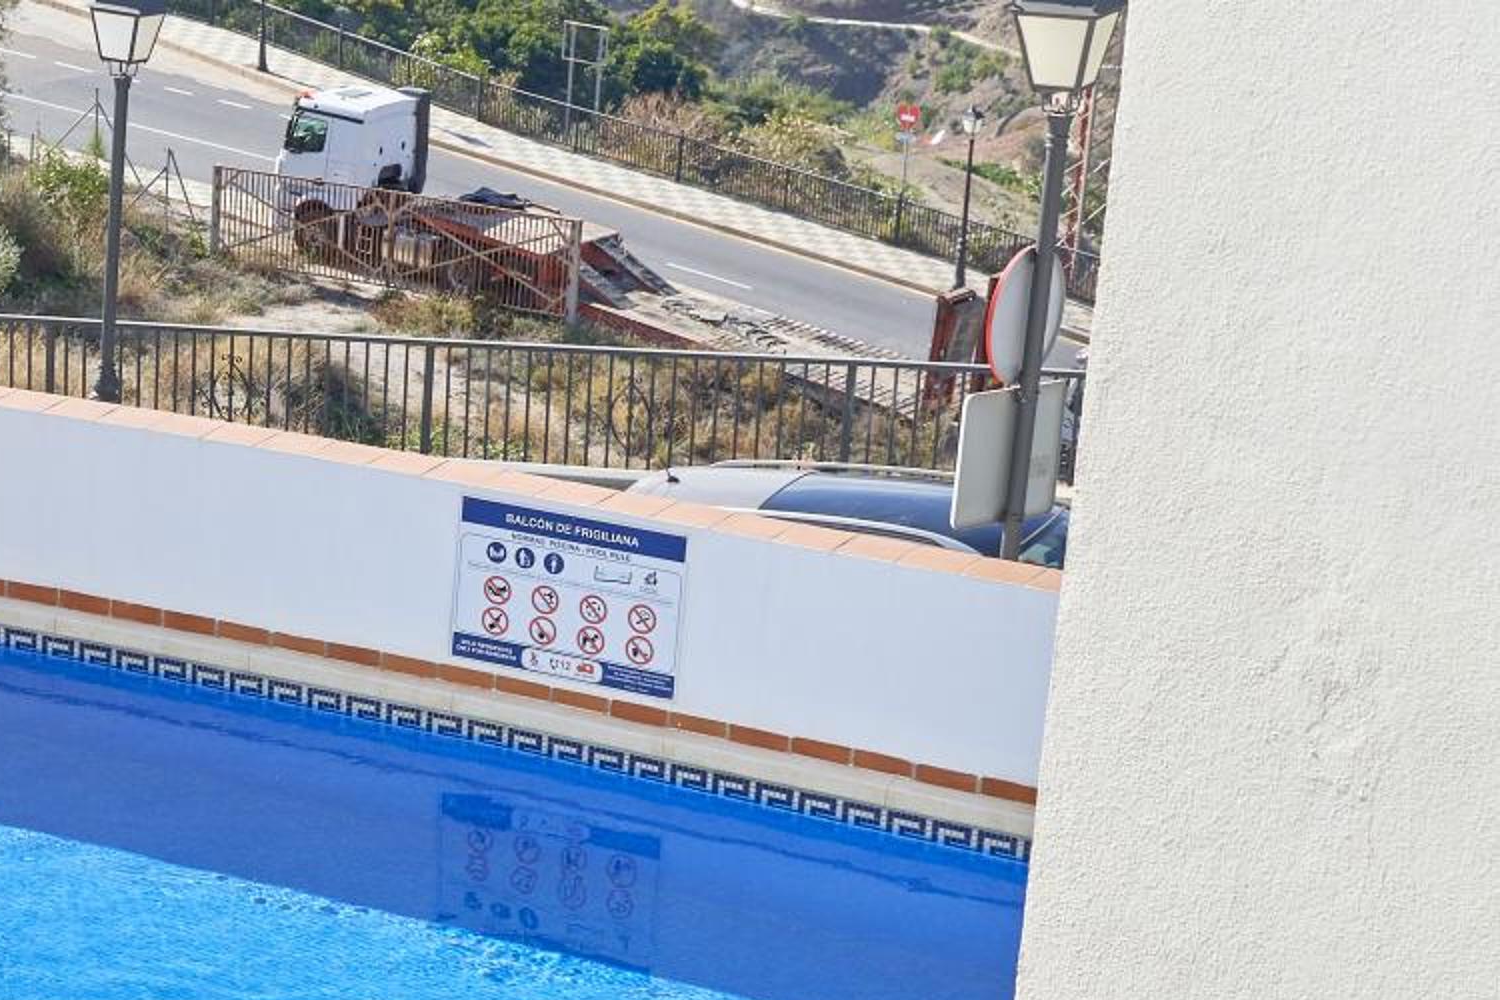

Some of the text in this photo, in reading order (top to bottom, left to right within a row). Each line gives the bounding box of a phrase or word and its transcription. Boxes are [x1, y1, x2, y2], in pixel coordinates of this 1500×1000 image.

[505, 513, 640, 548] BALCÓN DE FRIGILIANA
